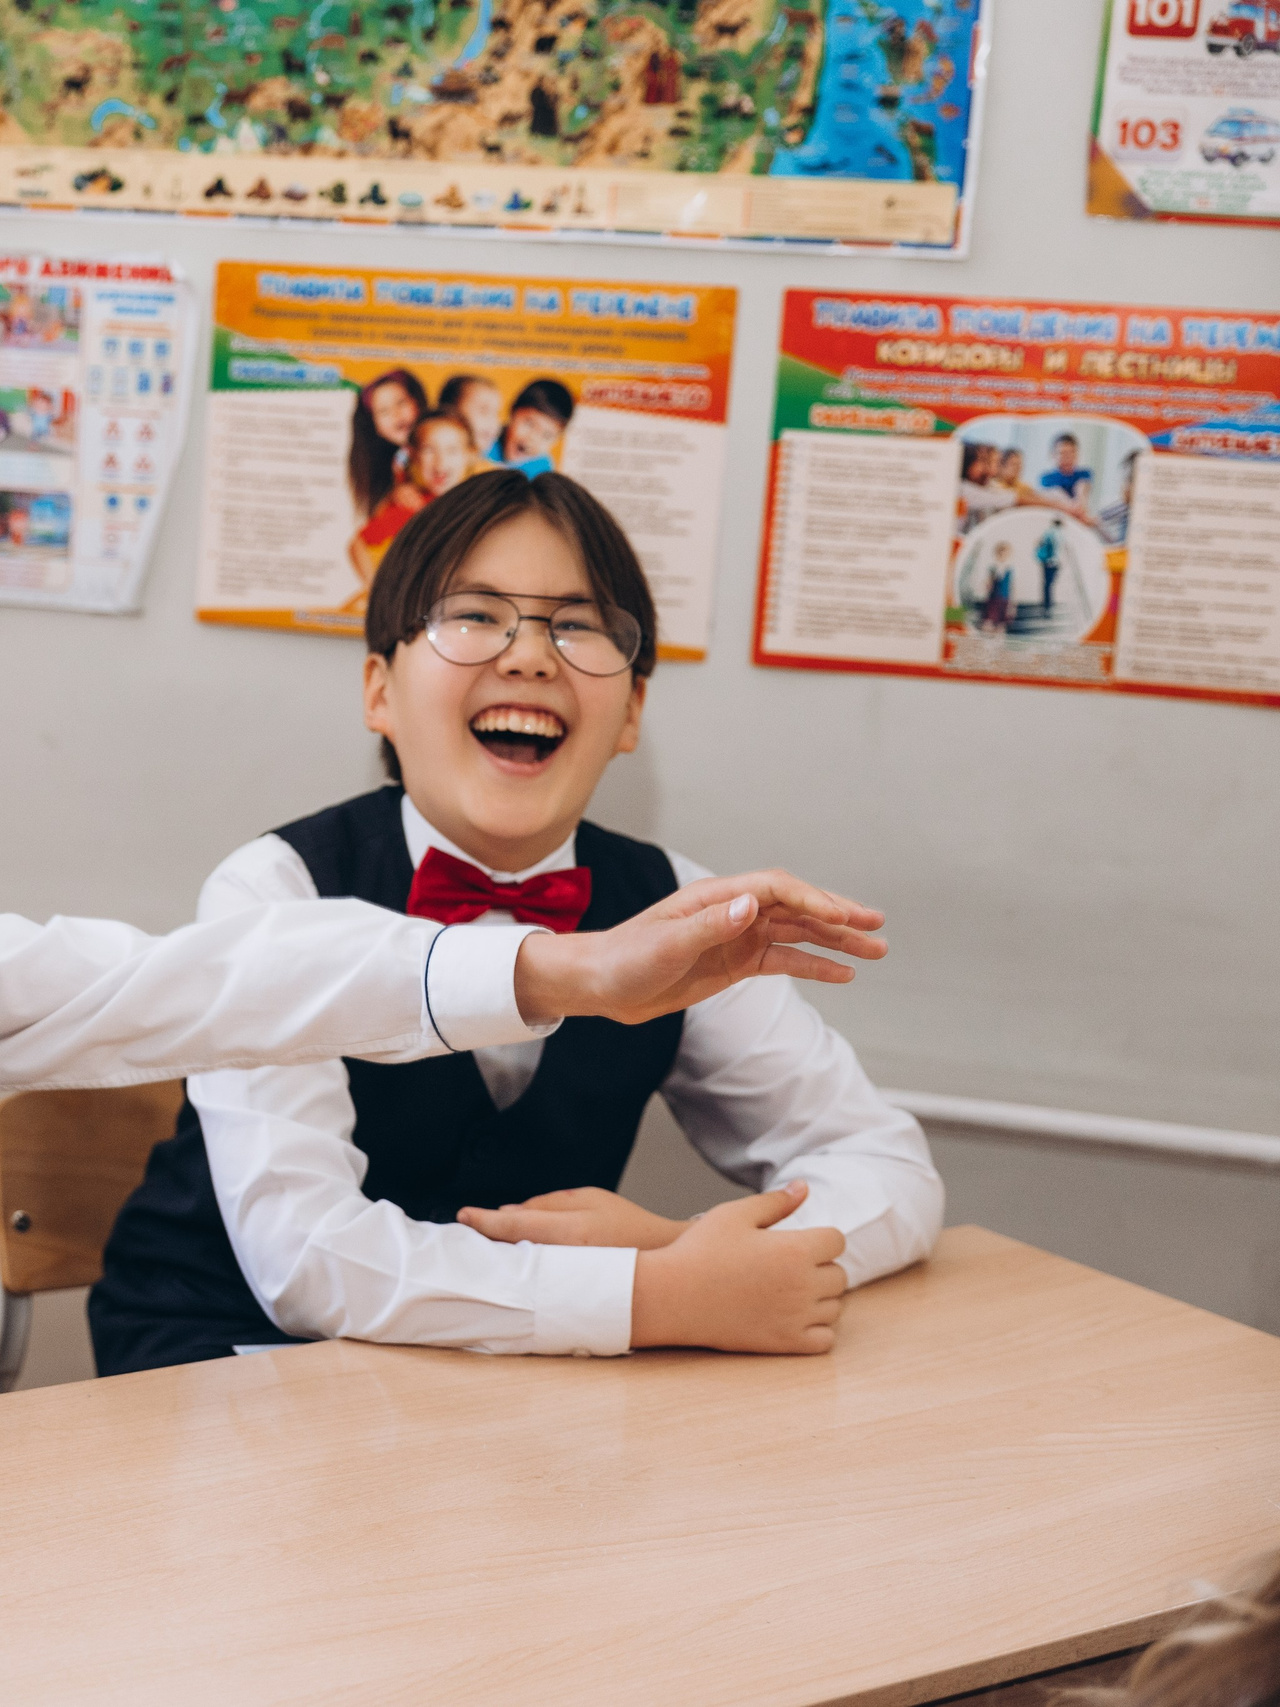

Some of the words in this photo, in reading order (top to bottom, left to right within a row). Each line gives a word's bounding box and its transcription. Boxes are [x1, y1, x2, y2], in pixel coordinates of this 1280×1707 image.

[1134, 0, 1195, 28] 101
[1118, 118, 1181, 152] 103
[1042, 347, 1068, 375] И
[1079, 349, 1238, 385] ЛЕСТНИЦЫ
